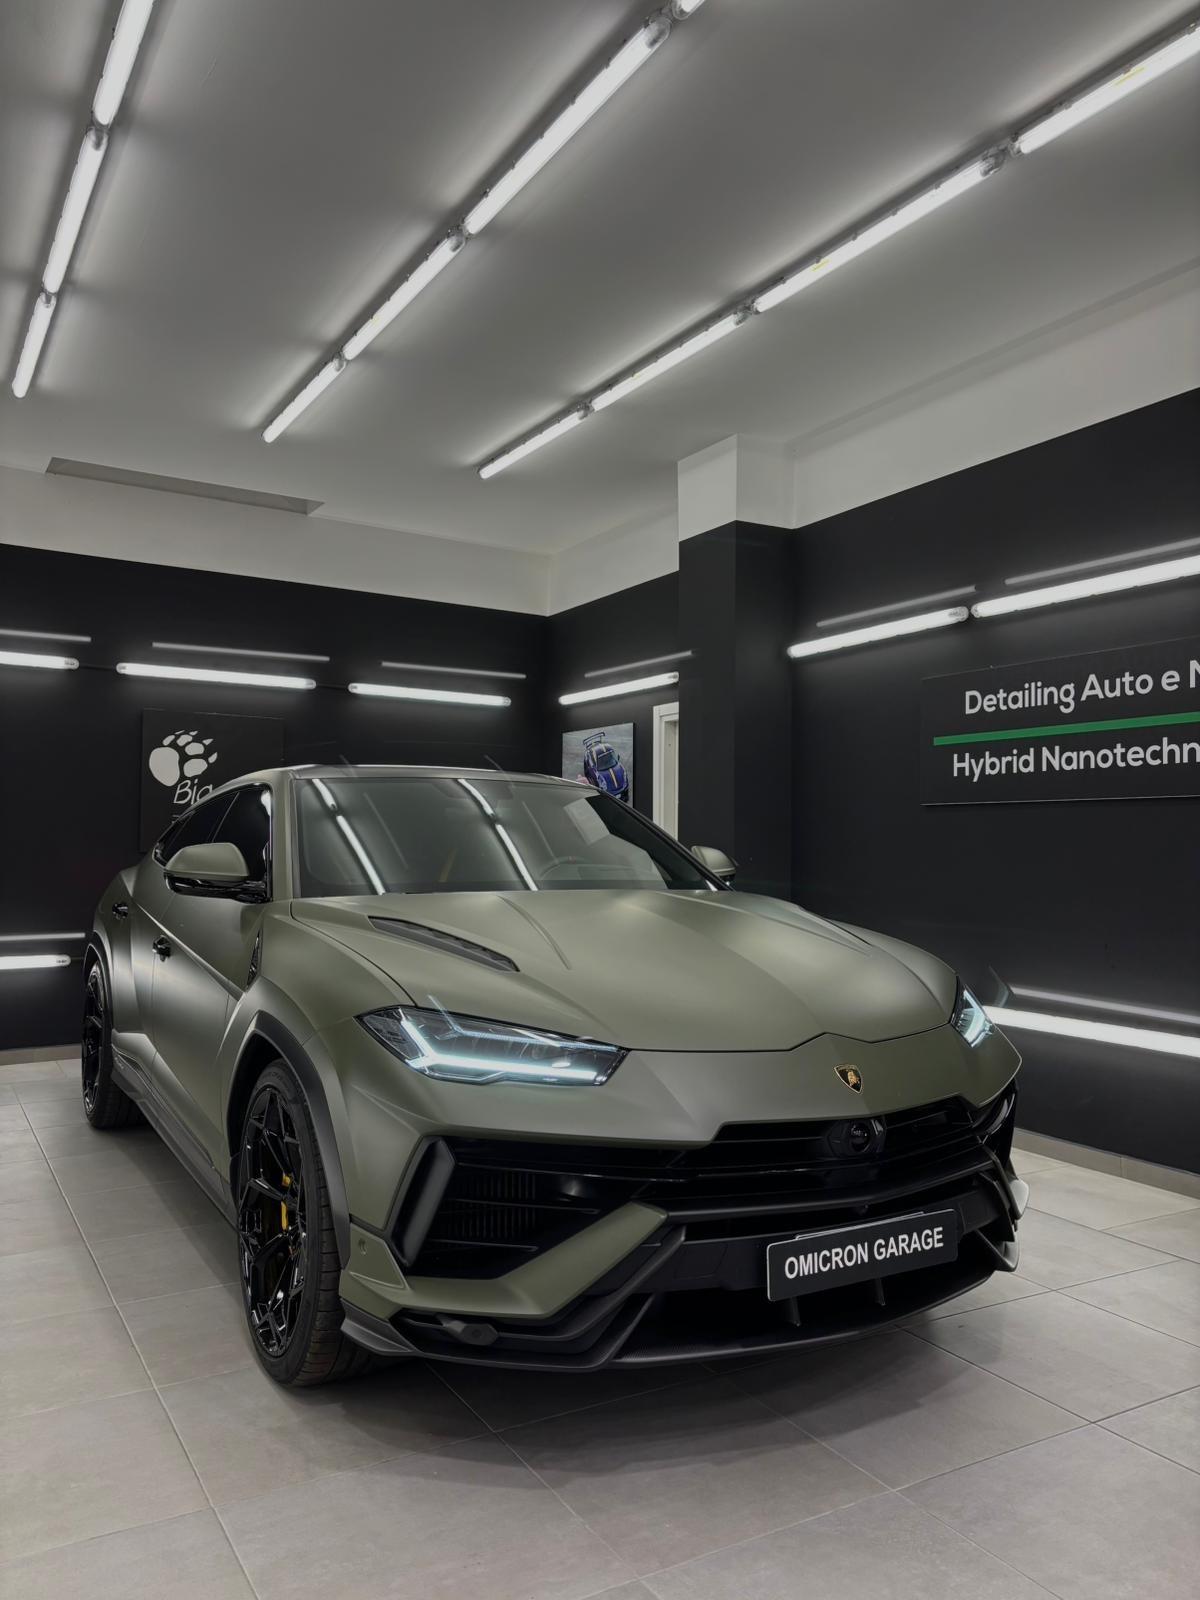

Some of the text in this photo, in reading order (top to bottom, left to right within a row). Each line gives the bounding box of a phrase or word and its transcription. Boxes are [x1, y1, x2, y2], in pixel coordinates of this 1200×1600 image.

[964, 681, 1076, 714] Detailing
[1080, 671, 1154, 701] Auto
[1160, 669, 1181, 692] e
[953, 737, 1200, 782] Hybrid Nanotechn
[784, 1226, 944, 1279] OMICRON GARAGE
